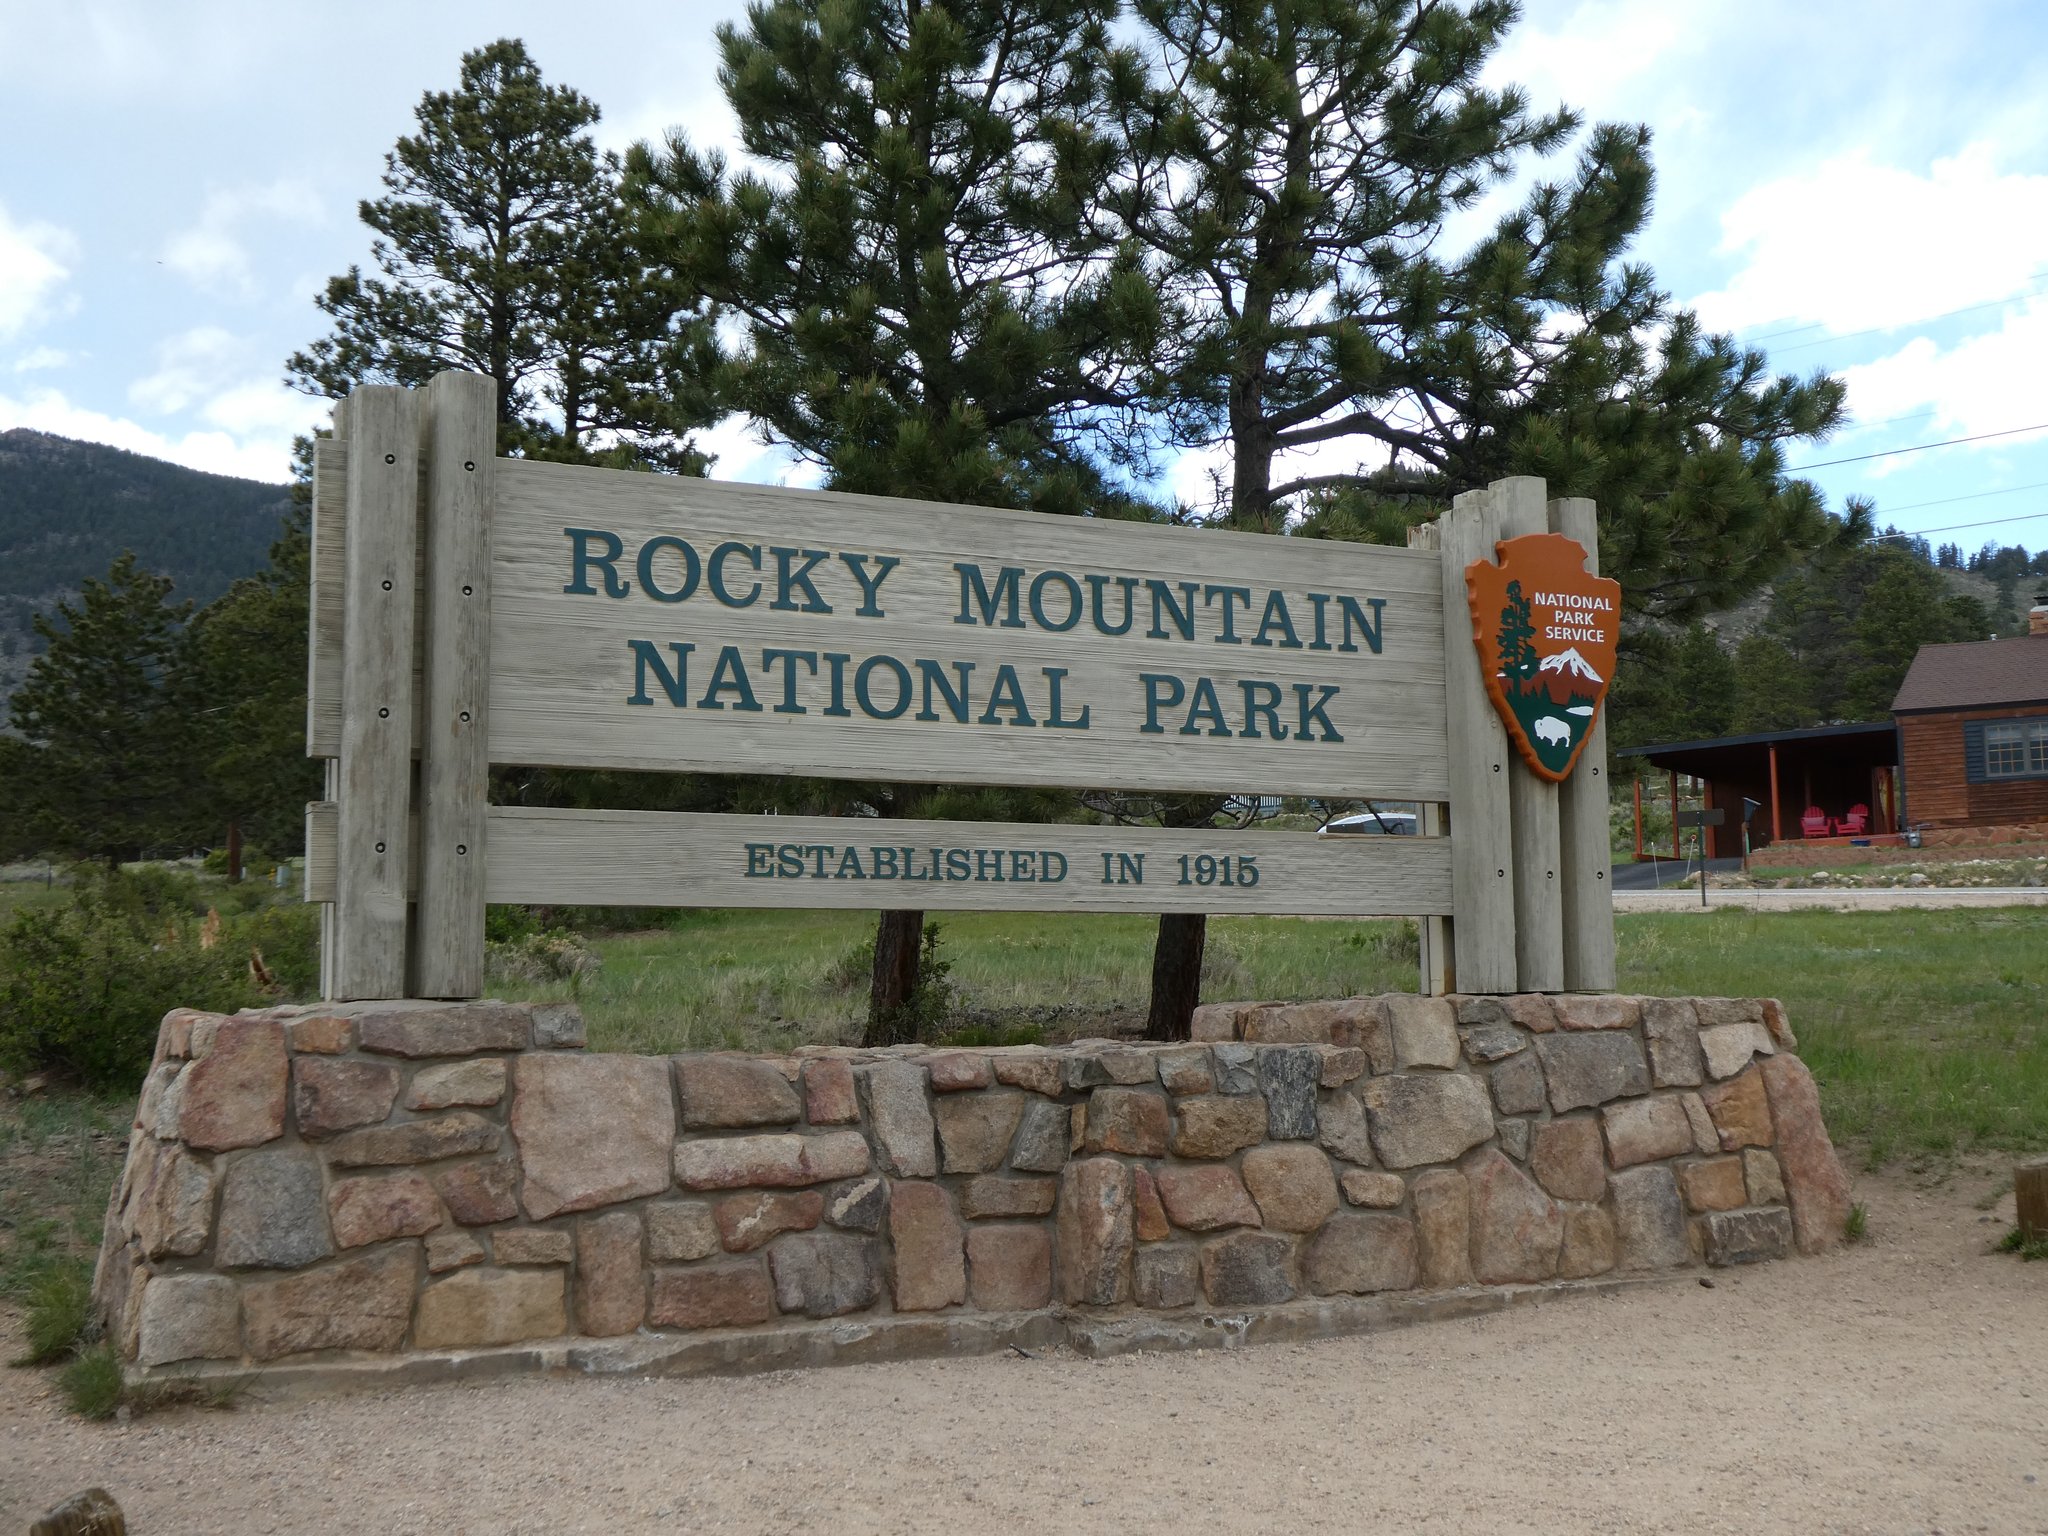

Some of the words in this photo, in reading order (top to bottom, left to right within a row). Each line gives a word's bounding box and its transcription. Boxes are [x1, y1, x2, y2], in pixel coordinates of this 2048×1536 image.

[563, 527, 900, 618] ROCKY
[953, 563, 1387, 654] MOUNTAIN
[1535, 591, 1613, 611] NATIONAL
[1545, 625, 1605, 643] SERVICE
[1555, 610, 1595, 626] PARK
[627, 640, 1090, 730] NATIONAL
[1139, 673, 1344, 742] PARK
[744, 843, 1069, 884] ESTABLISHED
[1101, 853, 1145, 885] IN
[1177, 854, 1260, 888] 1915
